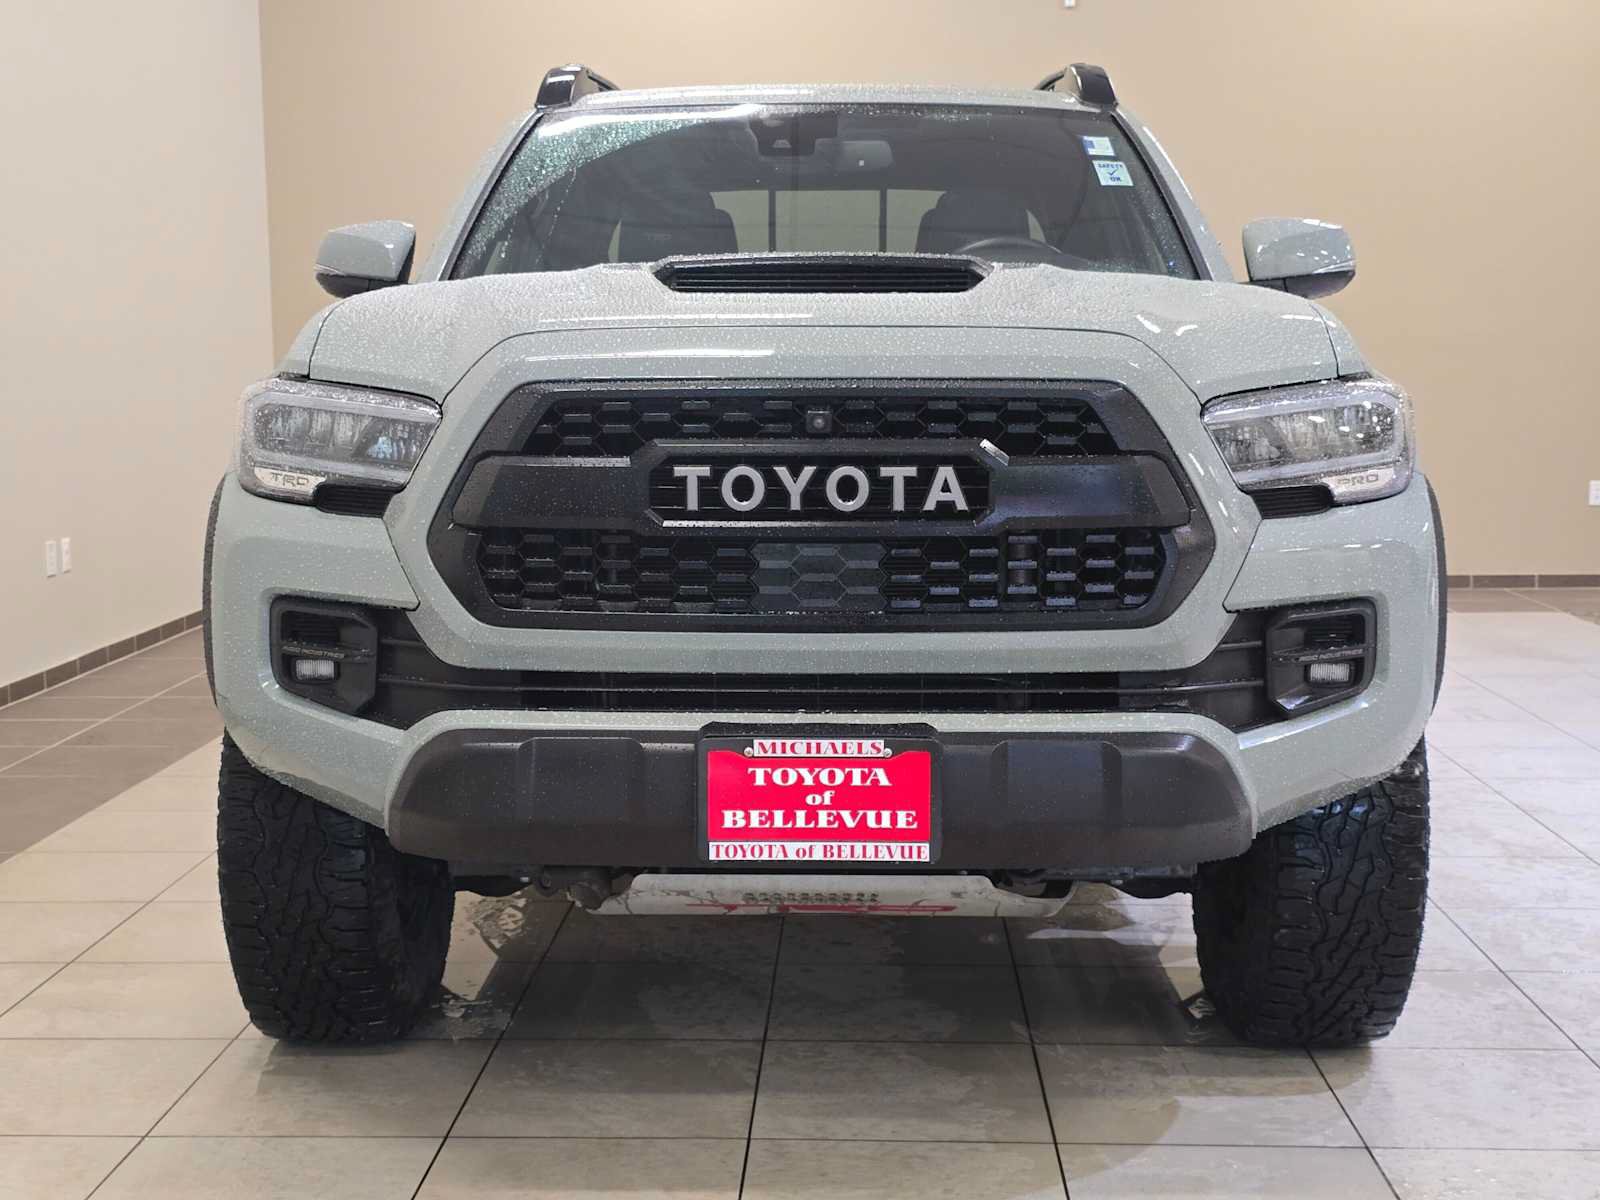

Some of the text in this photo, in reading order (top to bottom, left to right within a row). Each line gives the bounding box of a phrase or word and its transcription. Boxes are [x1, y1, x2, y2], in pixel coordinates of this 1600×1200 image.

[271, 472, 310, 487] TRD
[1337, 473, 1379, 486] PRO
[672, 466, 969, 512] TOYOTA
[757, 741, 883, 756] MICHAELS
[747, 767, 893, 787] TOYOTA
[805, 790, 836, 806] of
[721, 810, 918, 829] BELLEVUE
[711, 843, 928, 860] TOYOTA of BELLEVUE
